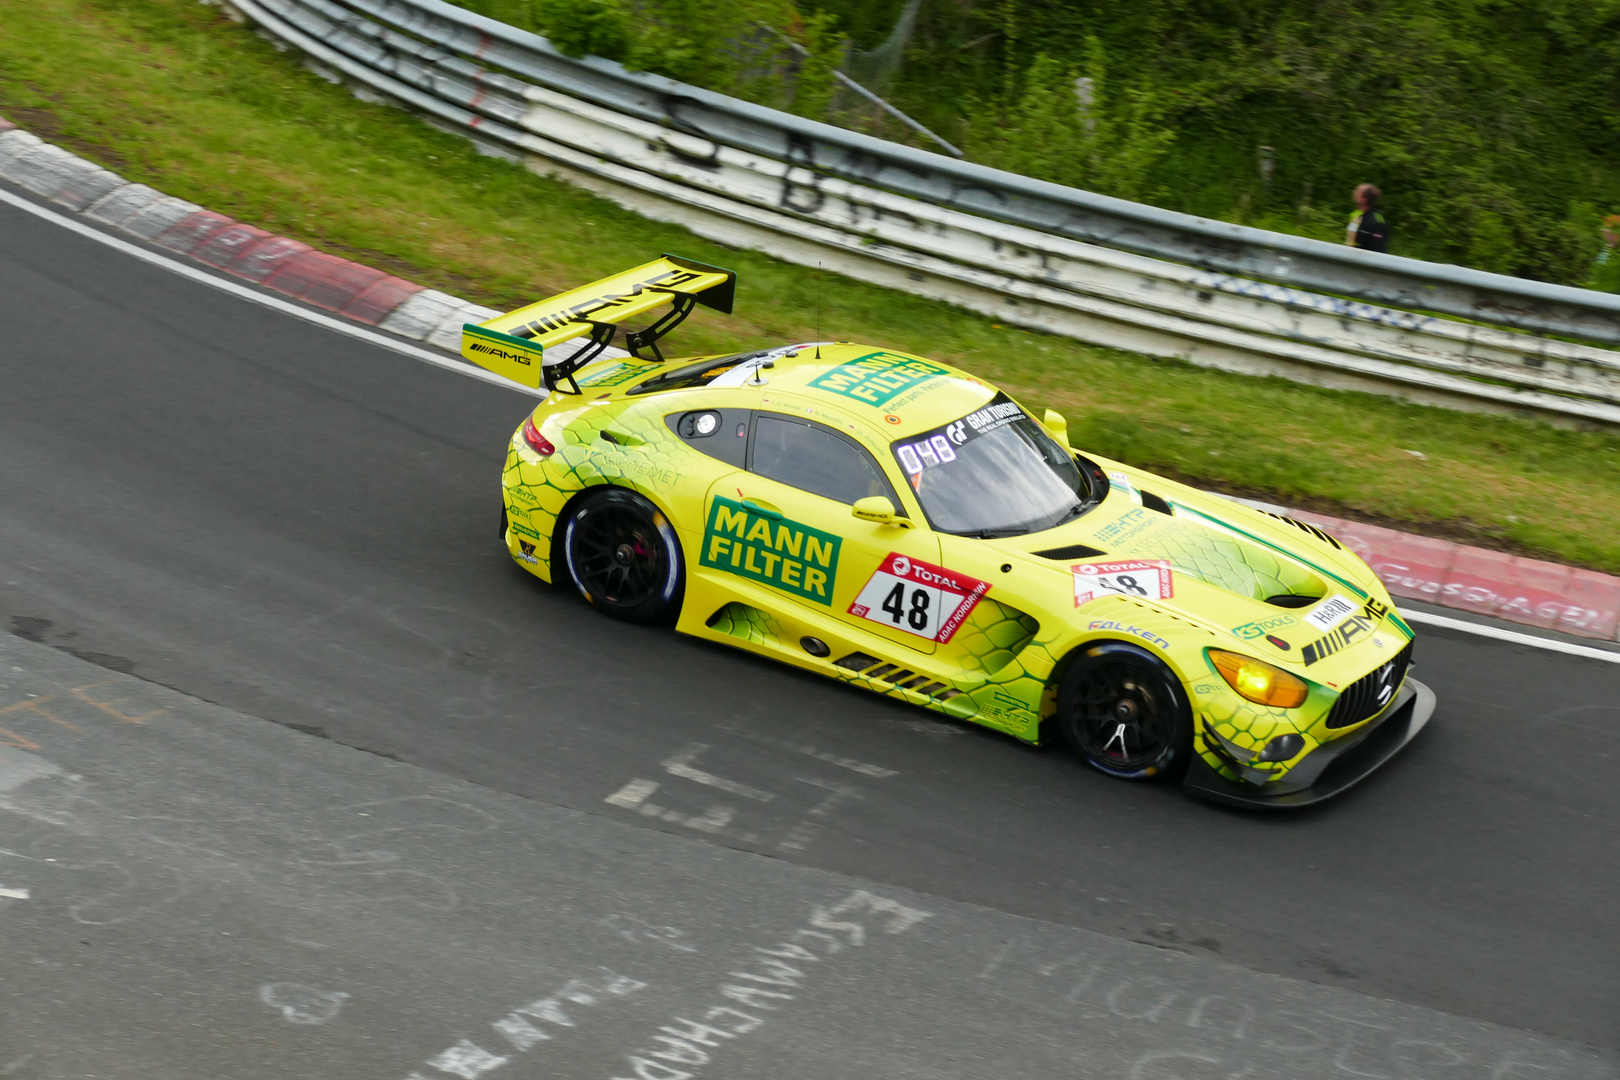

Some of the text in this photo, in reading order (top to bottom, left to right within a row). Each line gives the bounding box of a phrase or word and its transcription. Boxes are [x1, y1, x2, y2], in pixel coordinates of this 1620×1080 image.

[569, 270, 702, 321] AMG
[489, 349, 532, 366] AMG
[818, 352, 908, 391] MANN
[849, 361, 941, 403] FILTER
[883, 397, 908, 414] Perfect
[966, 402, 1021, 430] GRAN TURISMO
[599, 450, 684, 487] TECHEMET
[897, 434, 957, 474] 048
[713, 504, 834, 568] MANN
[708, 534, 828, 597] FILTER
[882, 581, 930, 631] 48
[1259, 616, 1295, 632] TOOLS
[1313, 602, 1343, 625] H&R
[1338, 597, 1389, 645] AMG
[938, 620, 956, 643] ADAC
[1087, 620, 1170, 649] FALKEN
